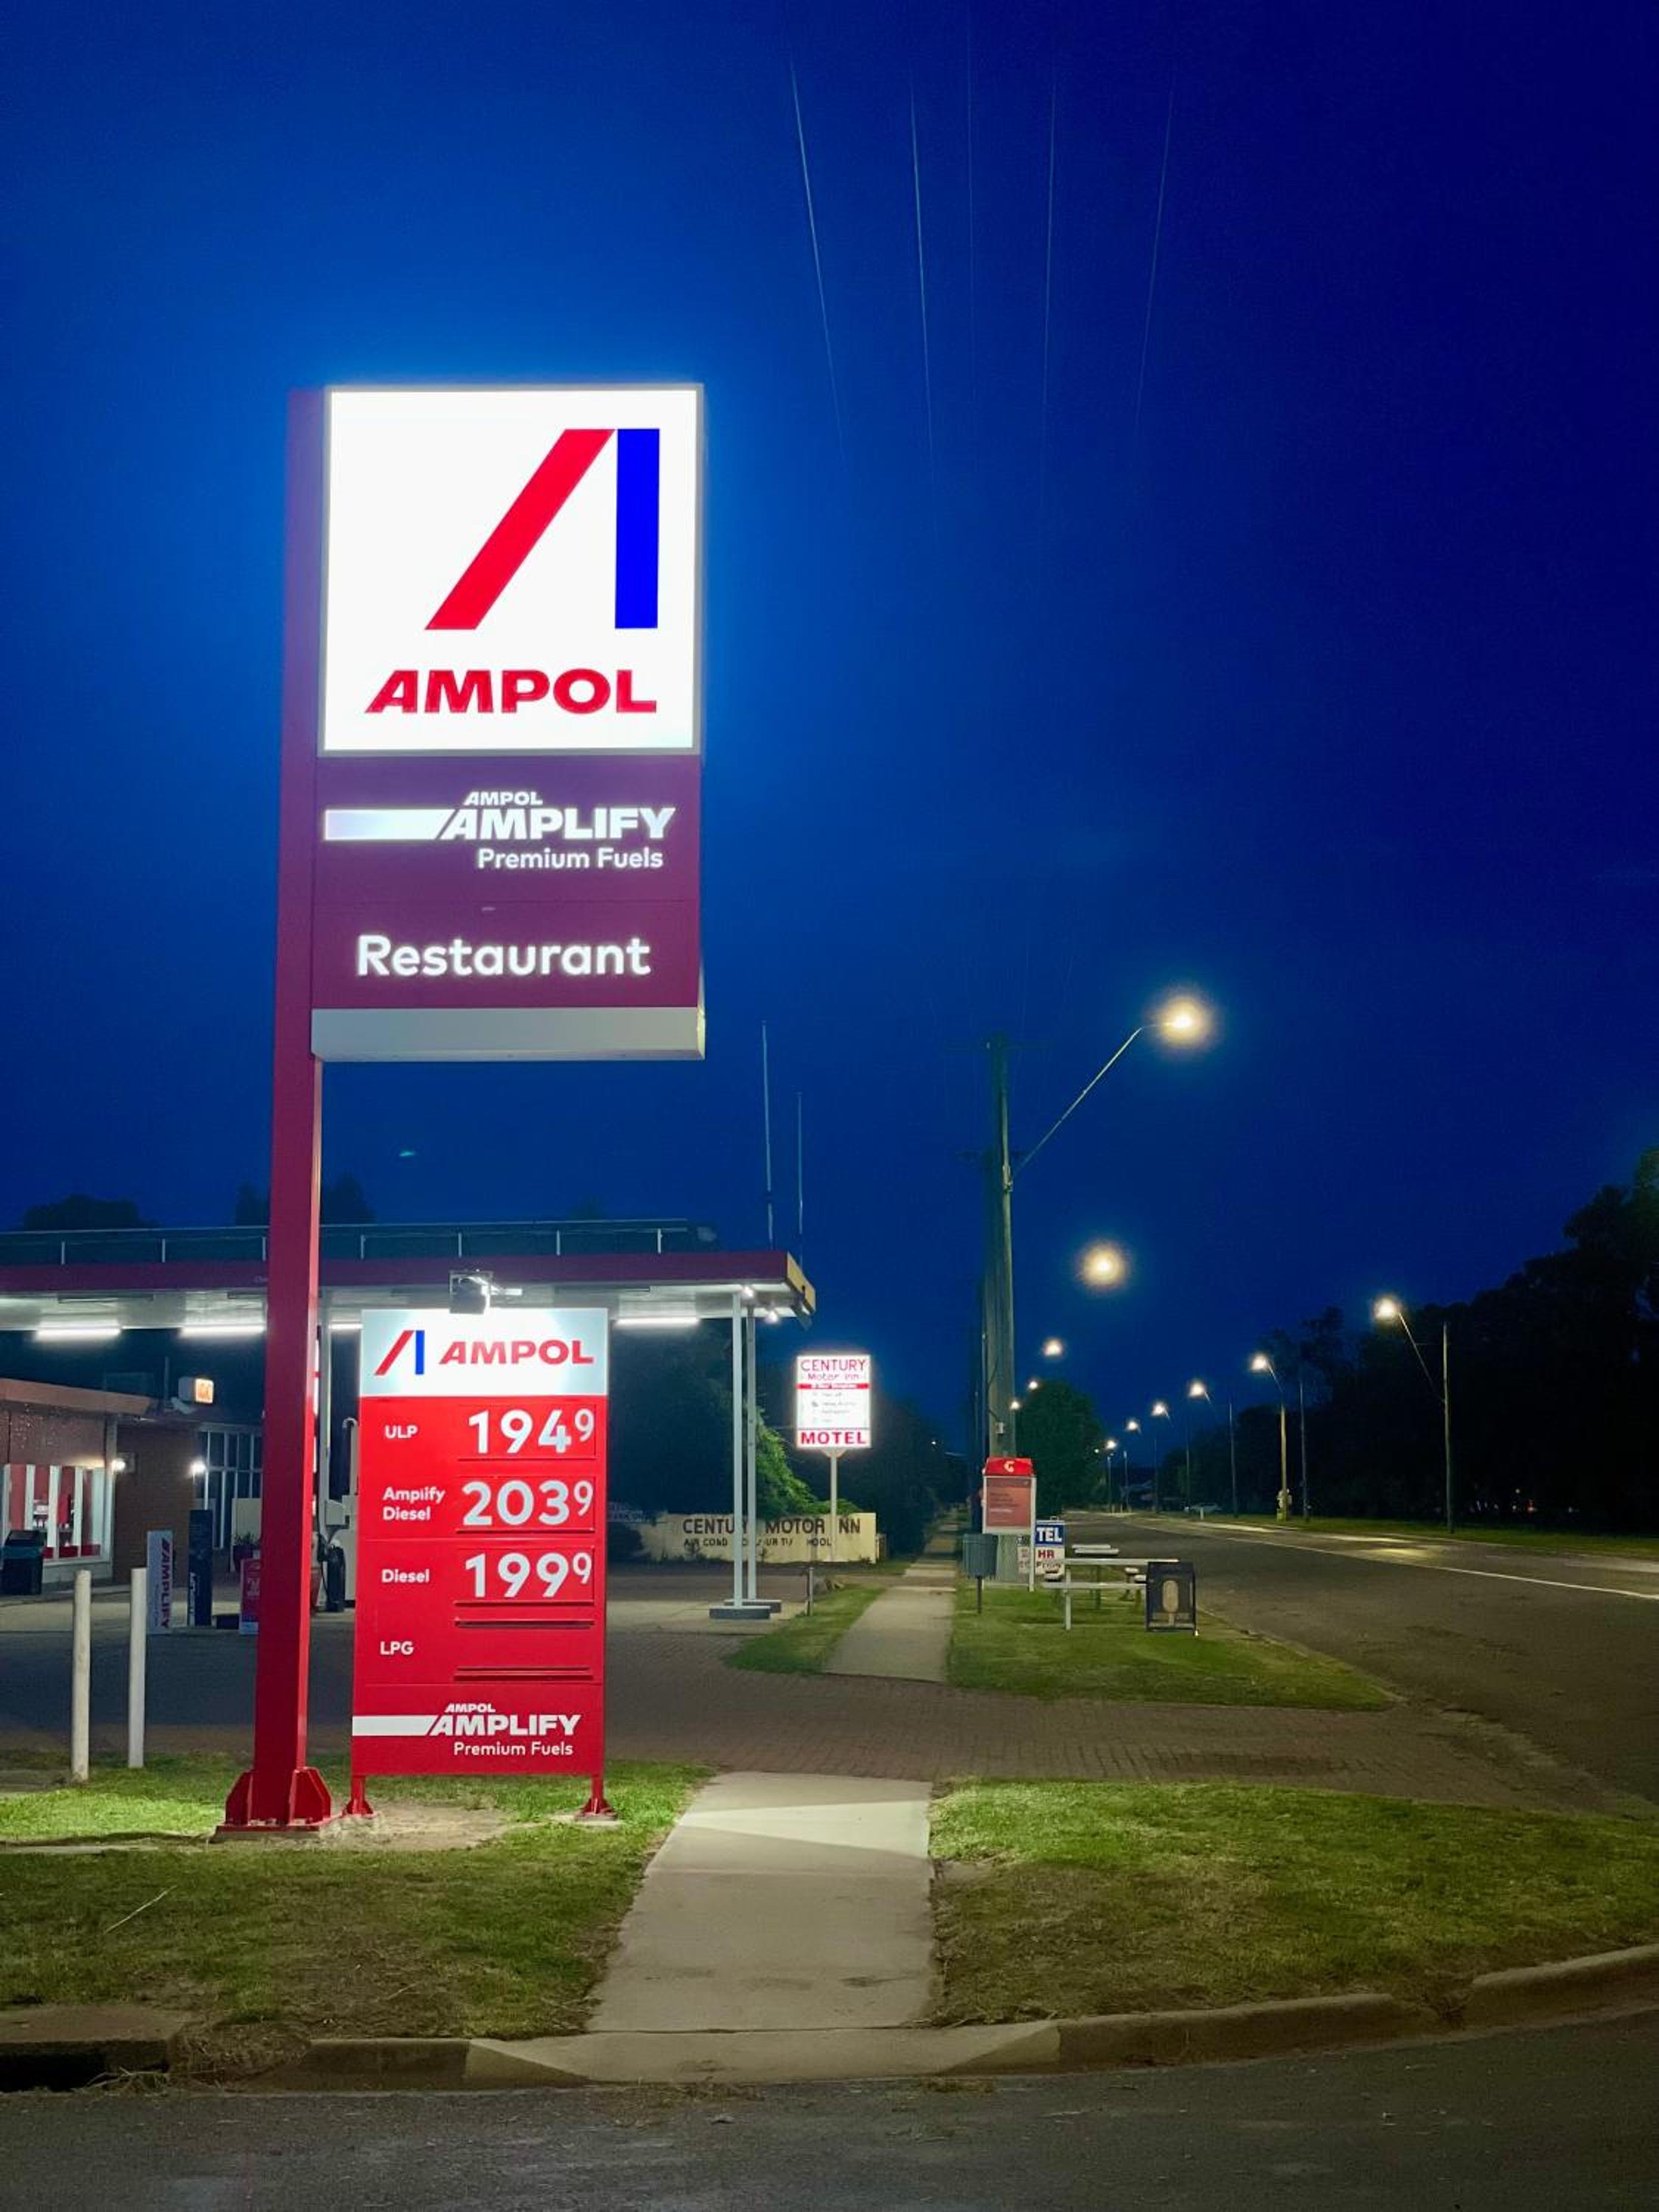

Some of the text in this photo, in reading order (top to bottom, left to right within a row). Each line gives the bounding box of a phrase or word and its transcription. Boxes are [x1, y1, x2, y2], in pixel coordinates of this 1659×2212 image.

[365, 668, 658, 715] AMPOL
[463, 790, 543, 806] AMPOL
[440, 808, 675, 840] AMPLIFY
[477, 846, 664, 869] Premium Fuels
[357, 933, 652, 977] Restaurant
[440, 1340, 594, 1365] AMPOL
[801, 1359, 866, 1371] CENTURY
[385, 1425, 418, 1439] ULP
[801, 1431, 866, 1444] MOTEL
[383, 1486, 445, 1503] Amplify
[383, 1506, 431, 1520] Diesel
[683, 1518, 748, 1534] CENTUY
[765, 1519, 825, 1534] MOTOR
[381, 1568, 430, 1583] Diesel
[380, 1641, 414, 1656] LPG
[445, 1703, 495, 1713] AMPOL
[429, 1715, 581, 1736] AMPLIFY
[454, 1742, 574, 1756] Premium Fuels
